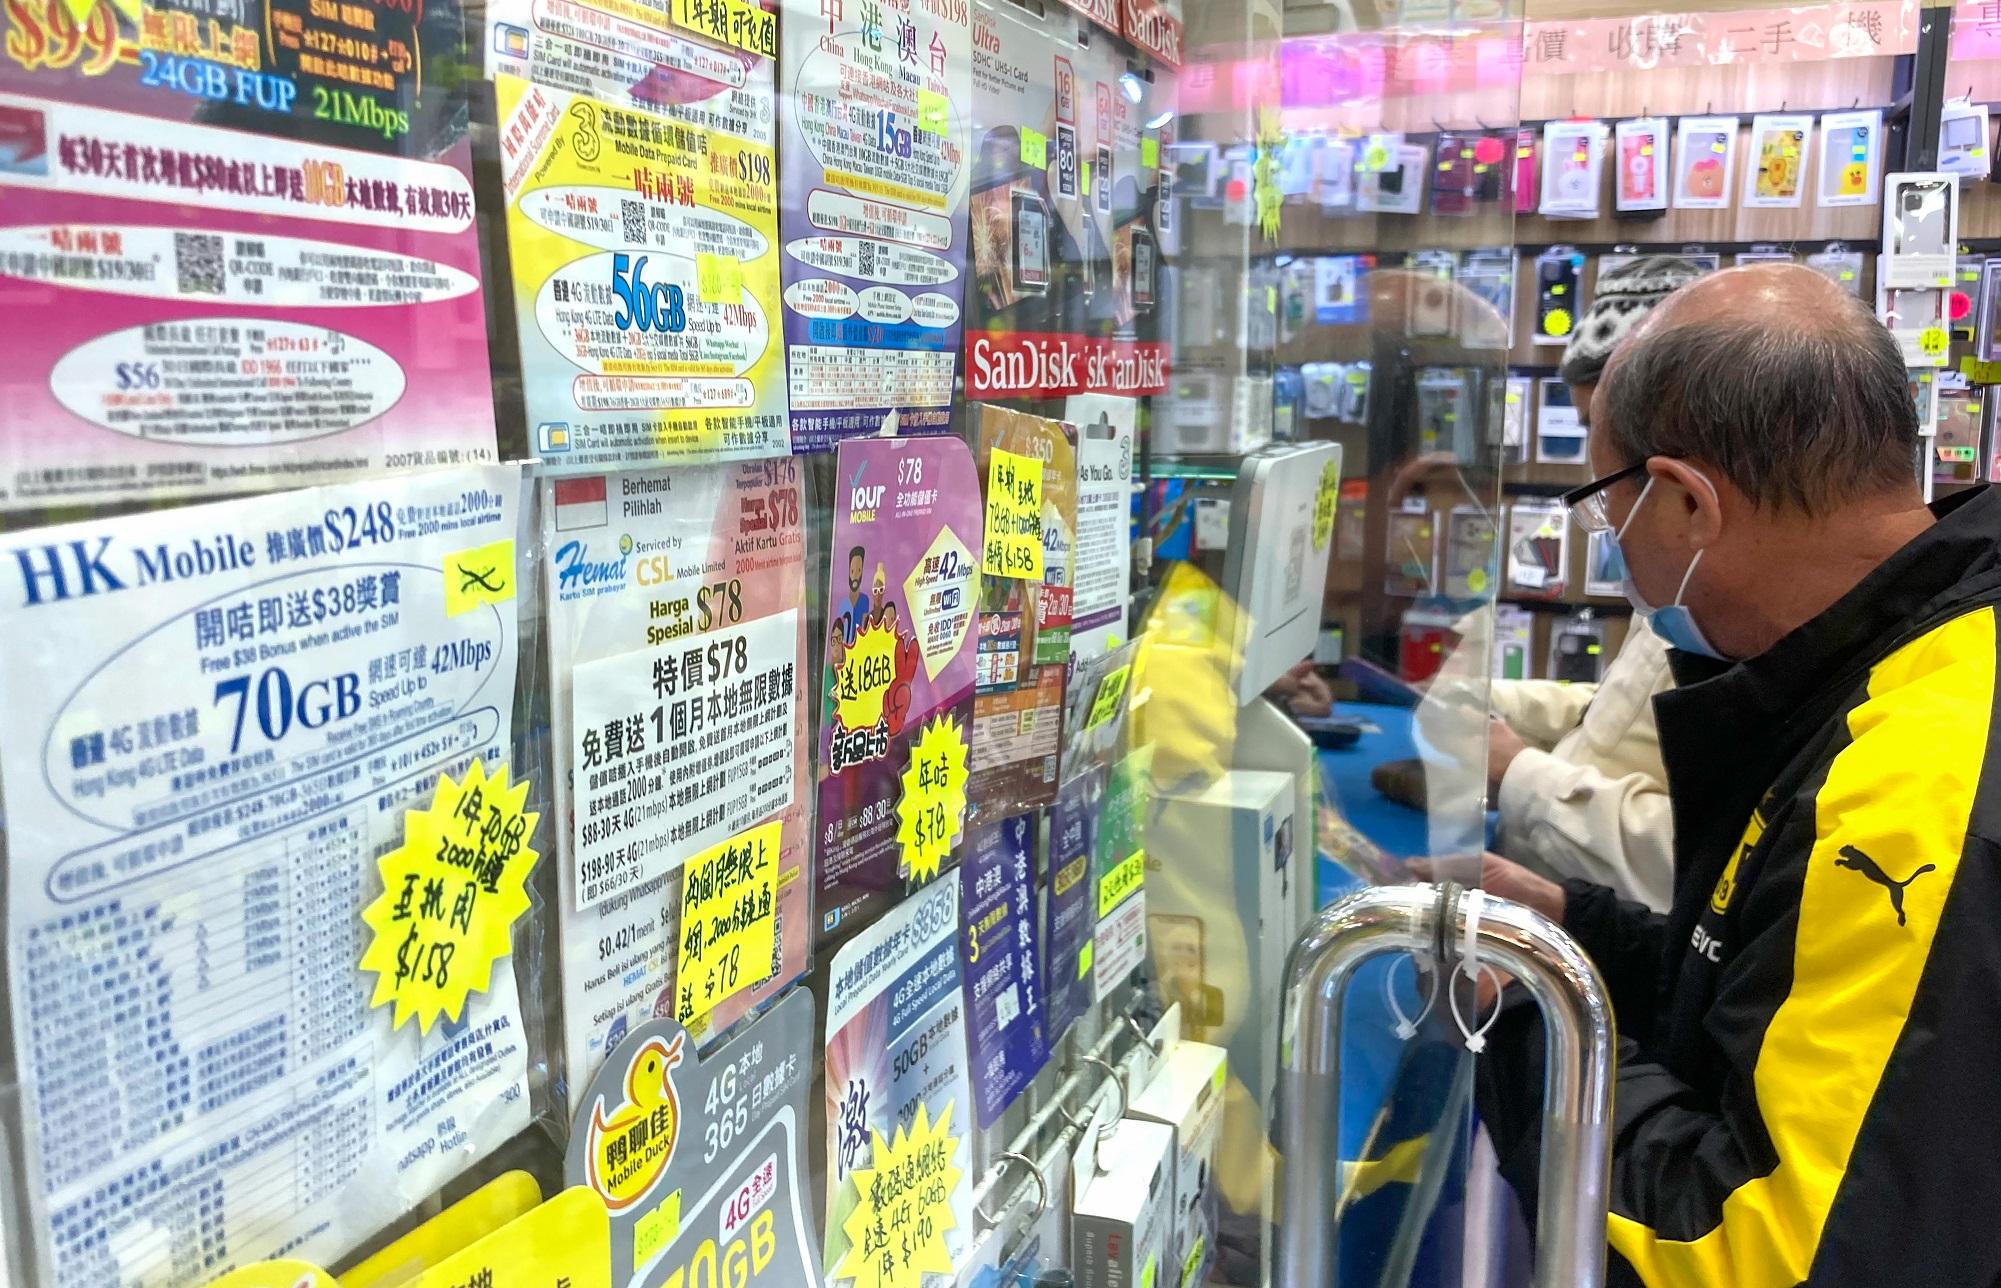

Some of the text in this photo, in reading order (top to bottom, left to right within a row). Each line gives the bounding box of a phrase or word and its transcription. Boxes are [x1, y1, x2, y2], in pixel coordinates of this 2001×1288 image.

[861, 0, 882, 52] 港
[896, 14, 918, 66] 澳
[929, 30, 947, 77] 台
[972, 22, 1001, 55] Ultra
[1128, 0, 1181, 67] SanDisk
[1727, 21, 1795, 56] 二手
[820, 33, 921, 86] China Hong Kong Macau
[1013, 65, 1029, 83] Card
[140, 53, 228, 100] 24GB
[236, 68, 297, 112] FUP
[1058, 70, 1070, 94] 16
[312, 87, 410, 139] 21Mbps
[876, 108, 912, 159] 15GB
[614, 139, 698, 169] Mobile Data Prepaid Card
[1059, 149, 1074, 172] 80
[612, 251, 687, 333] 56GB
[688, 317, 708, 333] Speed
[723, 302, 758, 334] 42Mbps
[117, 362, 160, 392] $56
[973, 338, 1079, 391] SanDisk
[1112, 348, 1168, 391] anDisk
[772, 439, 785, 449] 2002
[622, 475, 671, 496] Berhemat
[897, 456, 923, 486] $78
[1080, 464, 1102, 482] As You
[622, 498, 662, 518] Pilihlah
[768, 488, 799, 532] $78
[849, 508, 876, 525] MOBILE
[266, 500, 396, 565] 推廣價$248
[398, 518, 459, 540] Free 2000 mins
[635, 537, 682, 553] Serviced by
[734, 532, 801, 555] Aktif Kartu Gratis
[1043, 528, 1058, 552] 42
[12, 533, 256, 609] HK Mobile
[555, 538, 628, 591] Hemat
[635, 555, 726, 587] CSL Mobile Limited
[735, 557, 754, 575] 2000
[914, 574, 938, 588] High Speed
[938, 550, 973, 581] 42 Mbps
[194, 569, 401, 651] 開咭即送$38獎賞
[559, 582, 627, 602] Kartu SIM prabayar
[649, 578, 743, 632] Harga $78
[200, 611, 400, 675] Free $38 Bonus when active the SIM
[646, 614, 694, 646] Spesial
[430, 637, 493, 675] 42Mbps
[652, 634, 748, 700] 特價$78
[213, 666, 362, 755] 70GB
[368, 675, 428, 709] Speed Up to
[581, 661, 794, 772] 免費送1個月本地無限數據
[581, 817, 622, 849] $88-30天
[623, 797, 668, 829] 4G(21mbps)
[580, 829, 670, 885] $198-90天 4G(21mbps)
[599, 872, 629, 896] $66/30
[910, 884, 955, 950] $358
[395, 922, 456, 991] $158
[599, 922, 637, 961] $0.42/1
[968, 924, 980, 964] 3
[584, 975, 607, 992] Harus
[607, 964, 621, 979] Beli
[623, 962, 647, 987] HEMAT
[704, 943, 740, 1001] $78
[593, 1005, 616, 1026] Setiap
[616, 999, 625, 1013] isi
[645, 977, 663, 996] Gratis
[893, 1033, 929, 1084] 50GB
[704, 1063, 736, 1115] 4G
[704, 1093, 748, 1165] 365
[606, 1136, 671, 1193] Mobile Duck
[725, 1186, 750, 1232] 4G
